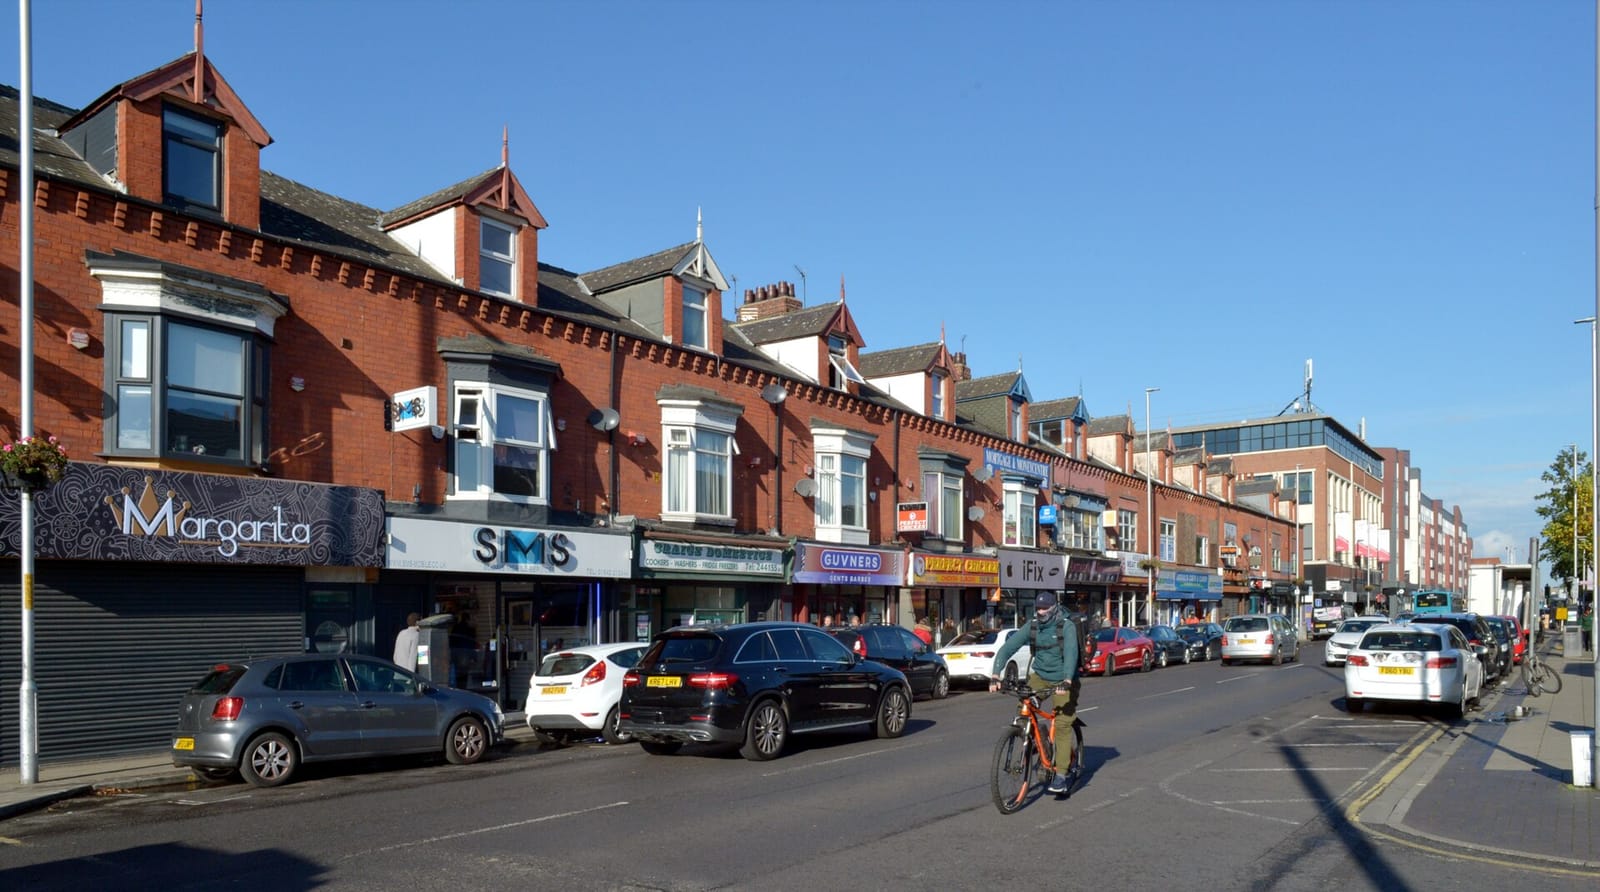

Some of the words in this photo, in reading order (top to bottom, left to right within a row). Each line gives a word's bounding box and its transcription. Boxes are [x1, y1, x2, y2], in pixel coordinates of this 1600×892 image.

[985, 450, 1011, 467] MORTGAGE
[123, 494, 311, 557] Margarita
[476, 528, 570, 567] SMS
[706, 546, 772, 561] DOMESTICS
[645, 558, 669, 567] COOKERS
[674, 560, 697, 569] WASHERS
[824, 553, 879, 569] GUVNERS
[1023, 560, 1044, 582] iFix
[830, 575, 848, 583] GENTS
[850, 576, 872, 584] BARBER
